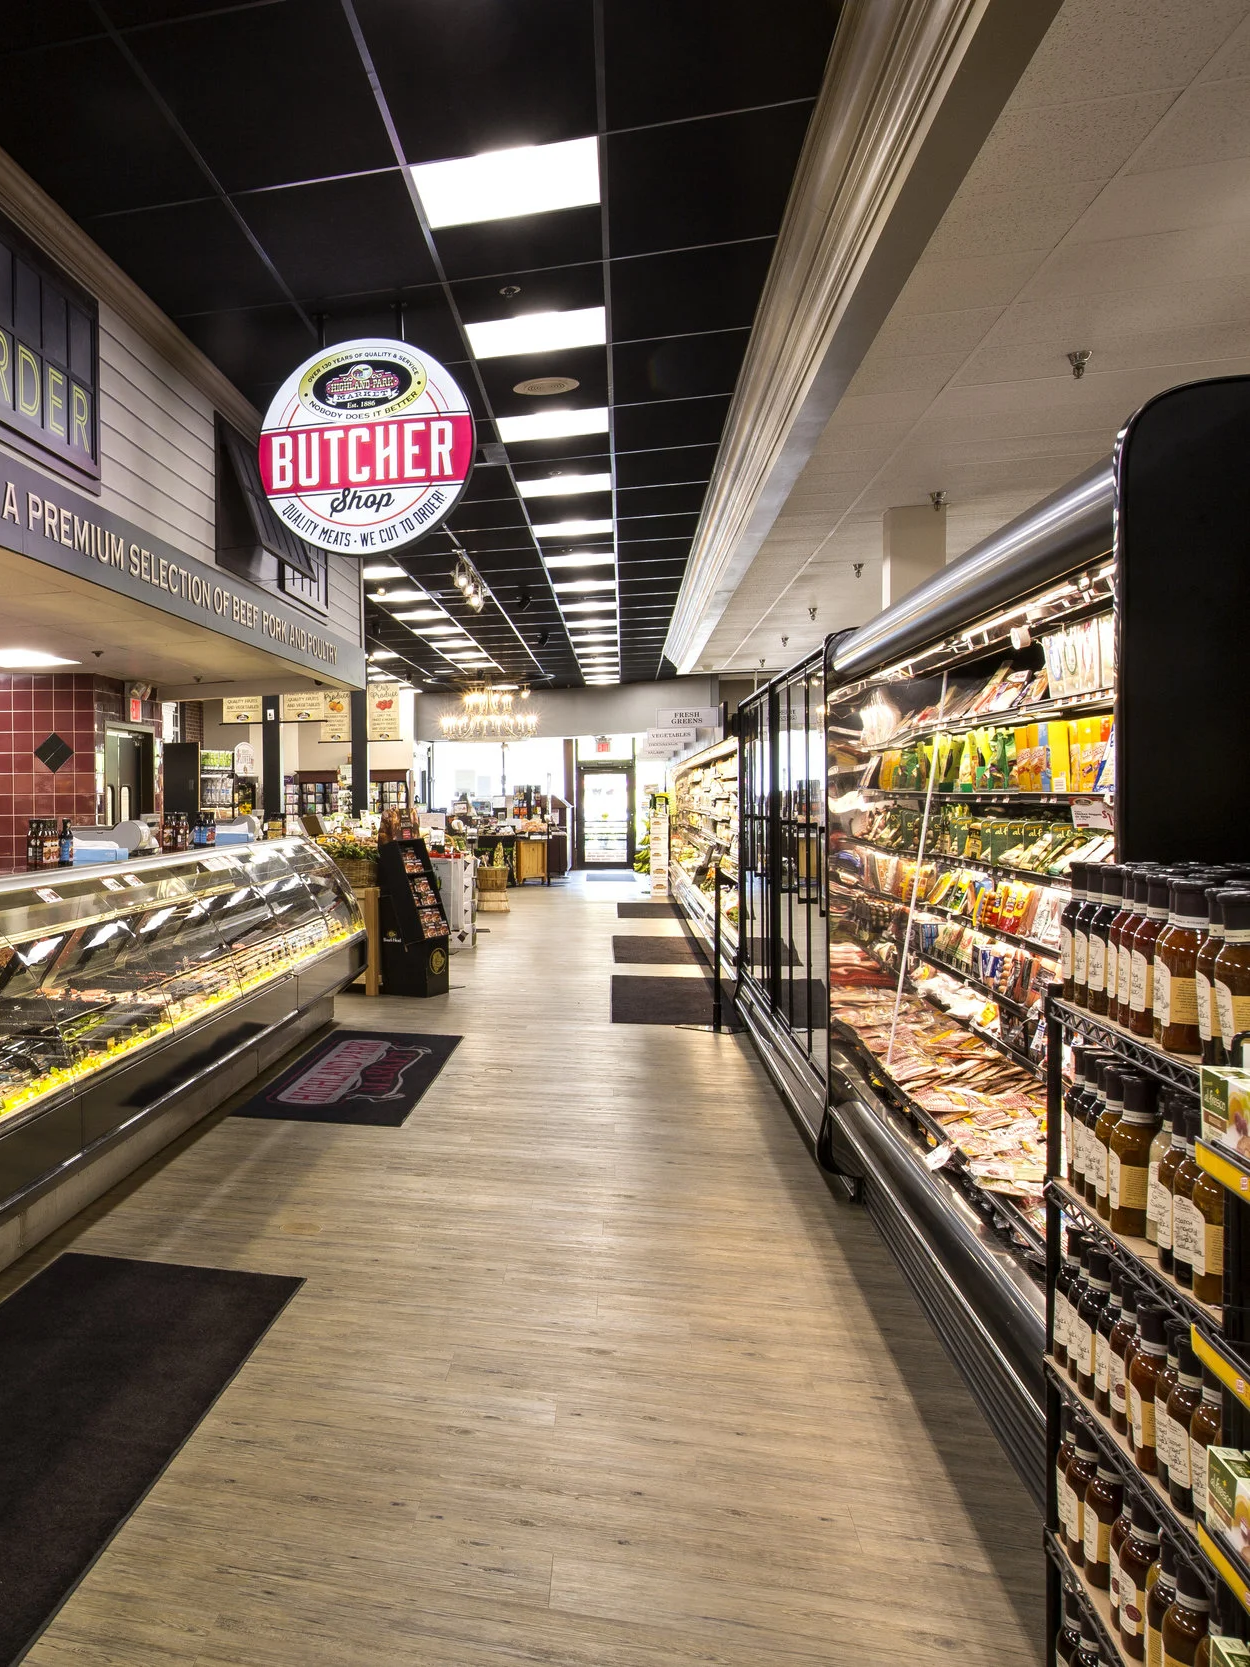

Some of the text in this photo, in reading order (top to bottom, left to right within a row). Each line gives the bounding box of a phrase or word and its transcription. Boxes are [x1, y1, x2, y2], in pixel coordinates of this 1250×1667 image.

[307, 368, 322, 383] OVER
[322, 361, 332, 371] 130
[333, 354, 354, 364] YEARS
[398, 356, 420, 376] SERVICE
[330, 377, 395, 393] HIGHLAND PARK
[336, 389, 390, 401] MARKET
[308, 390, 418, 420] NOBODY DOES IT BETTER
[346, 401, 359, 409] Est.
[270, 419, 454, 490] BUTCHER
[282, 489, 449, 547] QUALITY MEATS WE CUT TO ORDER!
[329, 487, 396, 518] Shop
[1, 480, 21, 526] A
[26, 491, 125, 571] PREMIUM
[128, 543, 211, 611] SELECTION
[213, 586, 230, 617] OF
[232, 595, 259, 631] BEEF
[261, 610, 288, 645] PORK
[289, 624, 306, 651] AND
[306, 632, 339, 666] POULTRY
[285, 1041, 384, 1102] HIGHLAND PARK
[358, 1051, 417, 1092] MARKET
